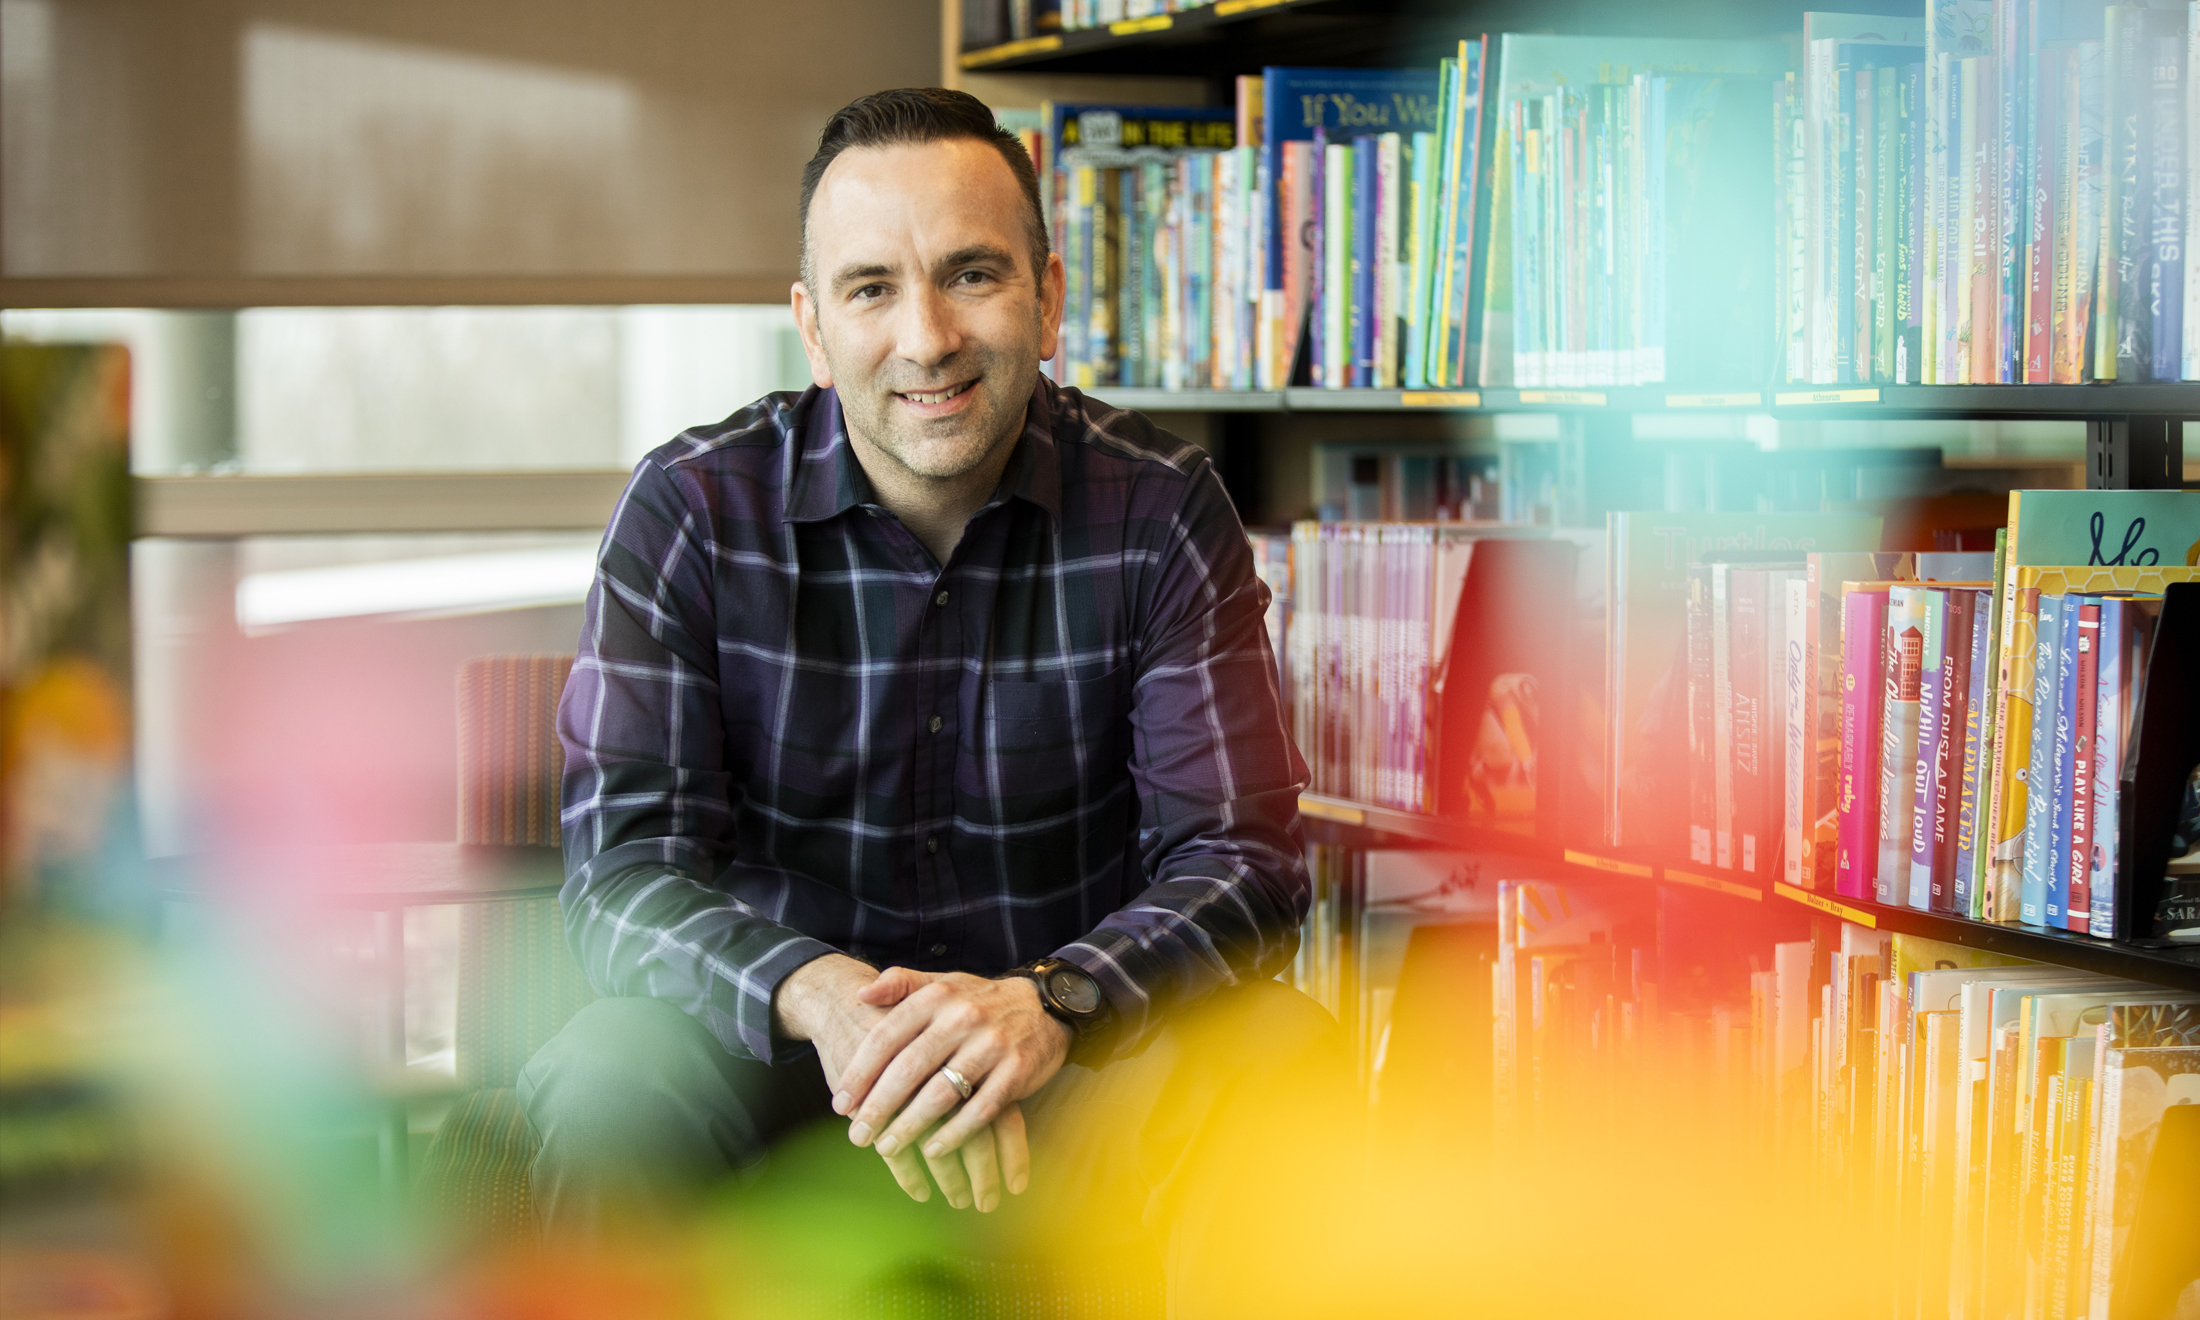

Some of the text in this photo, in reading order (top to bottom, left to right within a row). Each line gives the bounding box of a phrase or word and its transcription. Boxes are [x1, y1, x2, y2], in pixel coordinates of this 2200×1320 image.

[1822, 54, 1830, 77] Rim
[1331, 92, 1389, 127] You
[2003, 101, 2011, 153] WANT
[2002, 159, 2011, 182] TO
[2078, 126, 2090, 177] WHEN
[2121, 114, 2137, 185] KIN
[1937, 181, 1945, 220] PROBLEM
[1973, 141, 1987, 257] Time to Roll
[2001, 187, 2011, 210] BE
[2026, 186, 2034, 207] ME
[2159, 98, 2180, 262] UNDER THIS
[1855, 129, 1866, 301] THE CLACKITY
[1875, 132, 1888, 329] NIGHTHOUSE KEEPER
[1937, 222, 1945, 242] WITH
[1948, 176, 1959, 263] MAID FOR IT
[1989, 202, 1997, 255] EVERYONE
[2001, 216, 2010, 226] A
[2031, 145, 2048, 293] TALK Santa TO ME
[2056, 122, 2072, 313] DAUGHTERS ODUMA
[2121, 195, 2136, 237] Rooted
[1937, 246, 1945, 284] PAJAMAS
[2001, 232, 2010, 278] VASE
[2075, 247, 2089, 294] BURN
[2117, 256, 2134, 283] Hope
[1812, 392, 1841, 403] Atheneum
[2007, 520, 2016, 541] Ruby
[1923, 605, 1932, 656] PANCHOLY
[1716, 655, 1725, 708] CLOUTIER
[1804, 641, 1815, 740] MESSY ROOTS
[1736, 692, 1751, 773] ANSUZ
[1788, 639, 1802, 831] Only Weekends
[1844, 702, 1855, 772] REMARKABLY
[2077, 697, 2085, 728] WILSON
[1880, 649, 1900, 840] The Chandler Legacies
[1934, 655, 1954, 844] FROM A FLAME
[1995, 725, 2005, 777] LADYBUG
[2023, 641, 2053, 885] This Place is Still Beautiful
[2053, 712, 2069, 796] Milagro's
[1840, 774, 1856, 814] ruby
[1914, 759, 1931, 804] OUT
[1957, 697, 1979, 851] MAPMAKER
[2052, 797, 2062, 829] Search
[2071, 759, 2087, 885] PLAY LIKE A GIRL
[1807, 894, 1844, 915] Balzer Bray
[1838, 992, 1846, 1024] Fungi
[1838, 1028, 1846, 1062] Grow
[2055, 1069, 2064, 1105] TEAGUE
[2029, 1129, 2040, 1185] BECOMING
[2067, 1155, 2076, 1182] EVEN
[2049, 1179, 2057, 1192] Are
[2057, 1155, 2069, 1231] EVEN ROBOTS
[2064, 1186, 2074, 1231] ROBOTS
[2062, 1234, 2071, 1257] CAN
[2098, 1237, 2111, 1298] SNOW MAN
